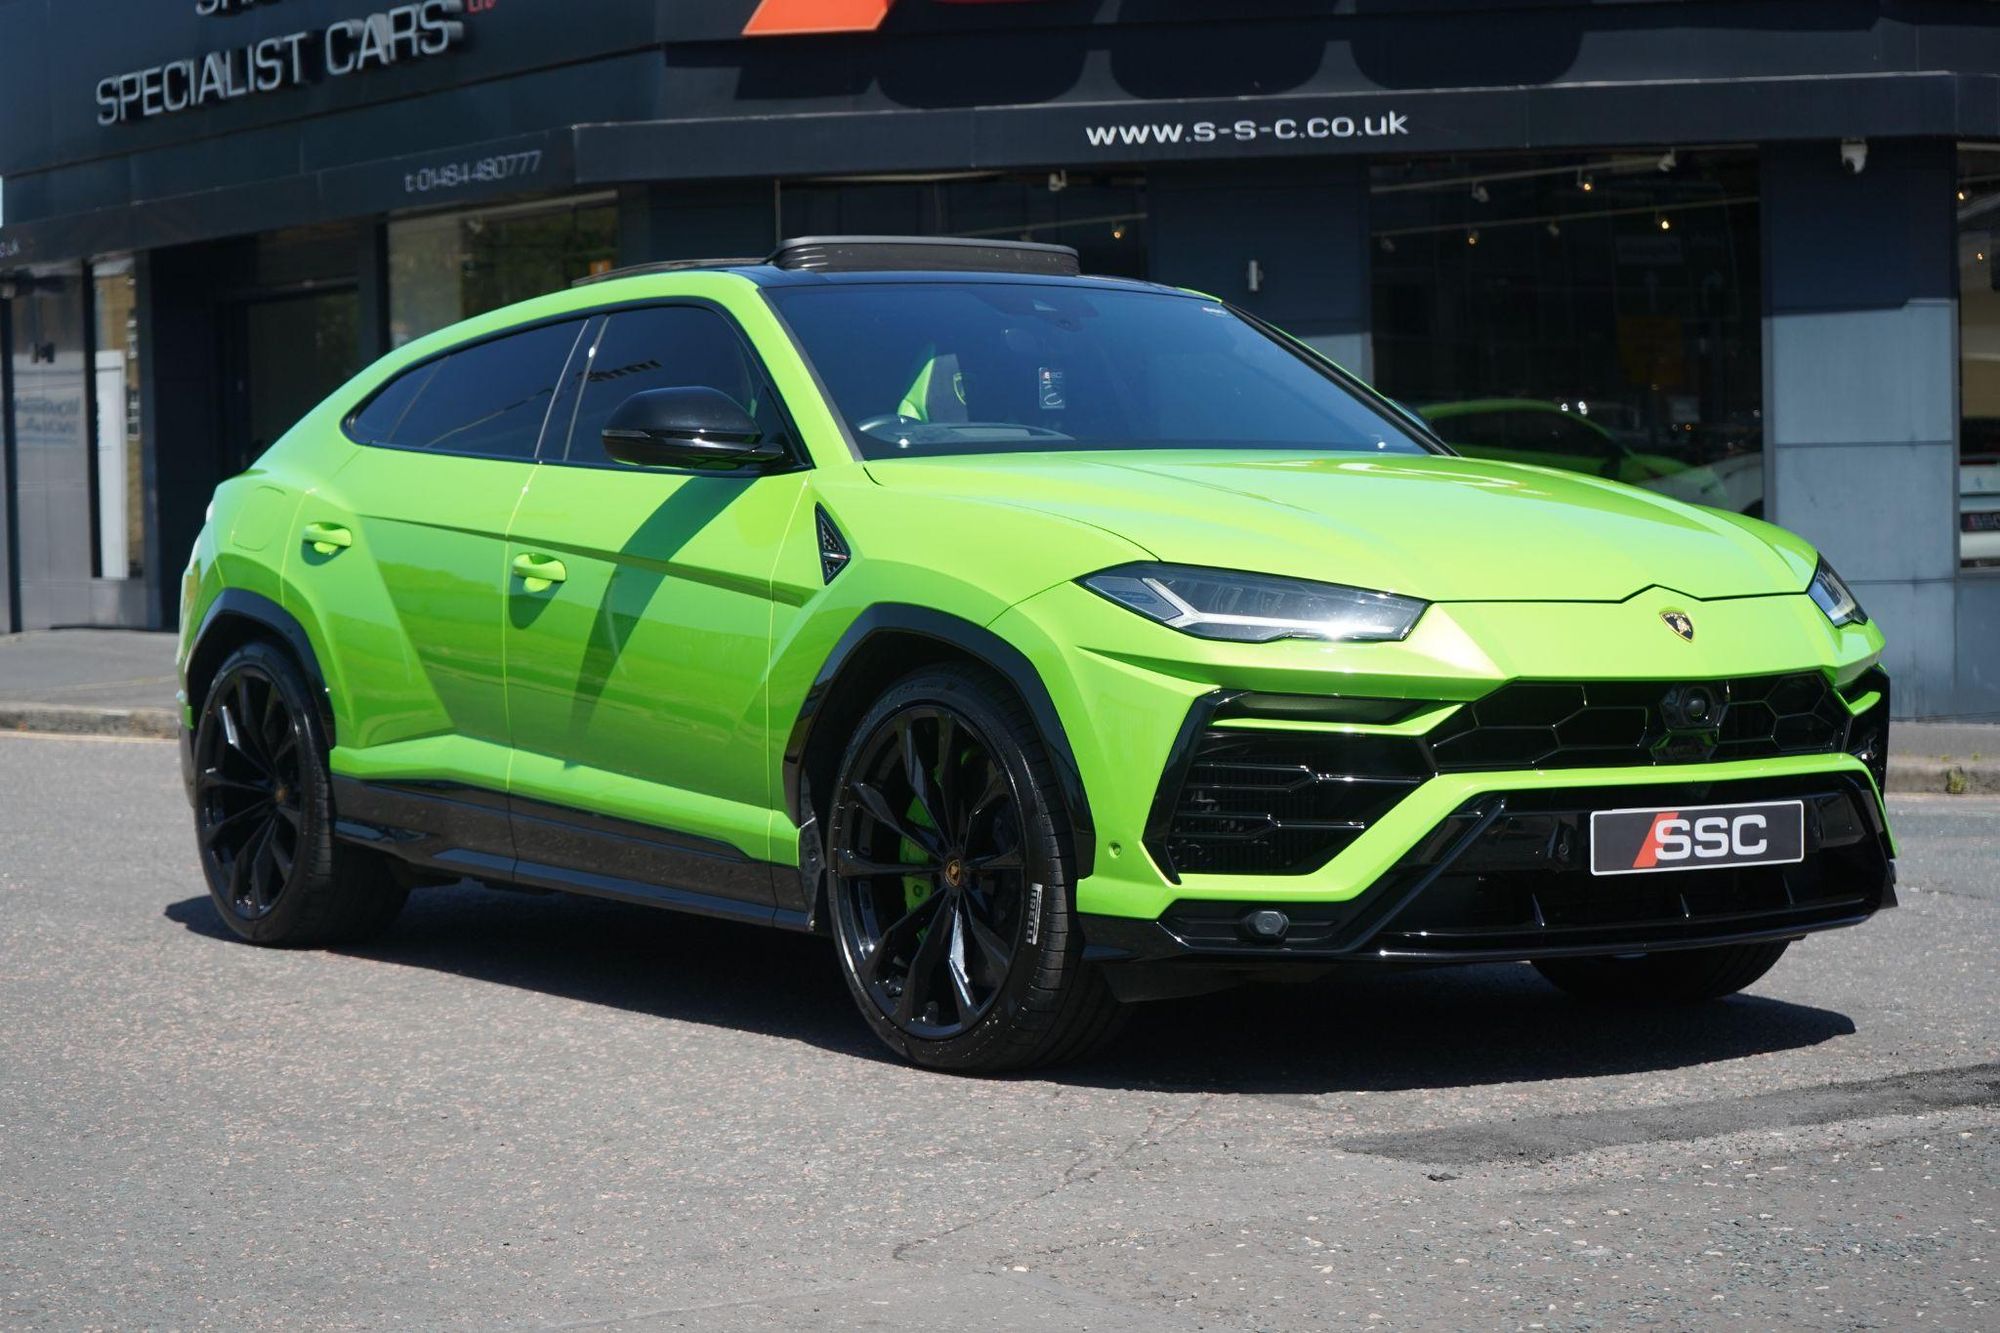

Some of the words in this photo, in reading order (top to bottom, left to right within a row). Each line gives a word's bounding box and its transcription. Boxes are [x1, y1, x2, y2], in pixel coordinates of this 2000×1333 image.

[96, 32, 307, 125] SPECIALIST
[325, 0, 456, 76] CARS
[1086, 110, 1409, 146] www.s-s-c.co.uk
[1655, 814, 1768, 861] SSC
[1025, 882, 1043, 945] PIRELLI
